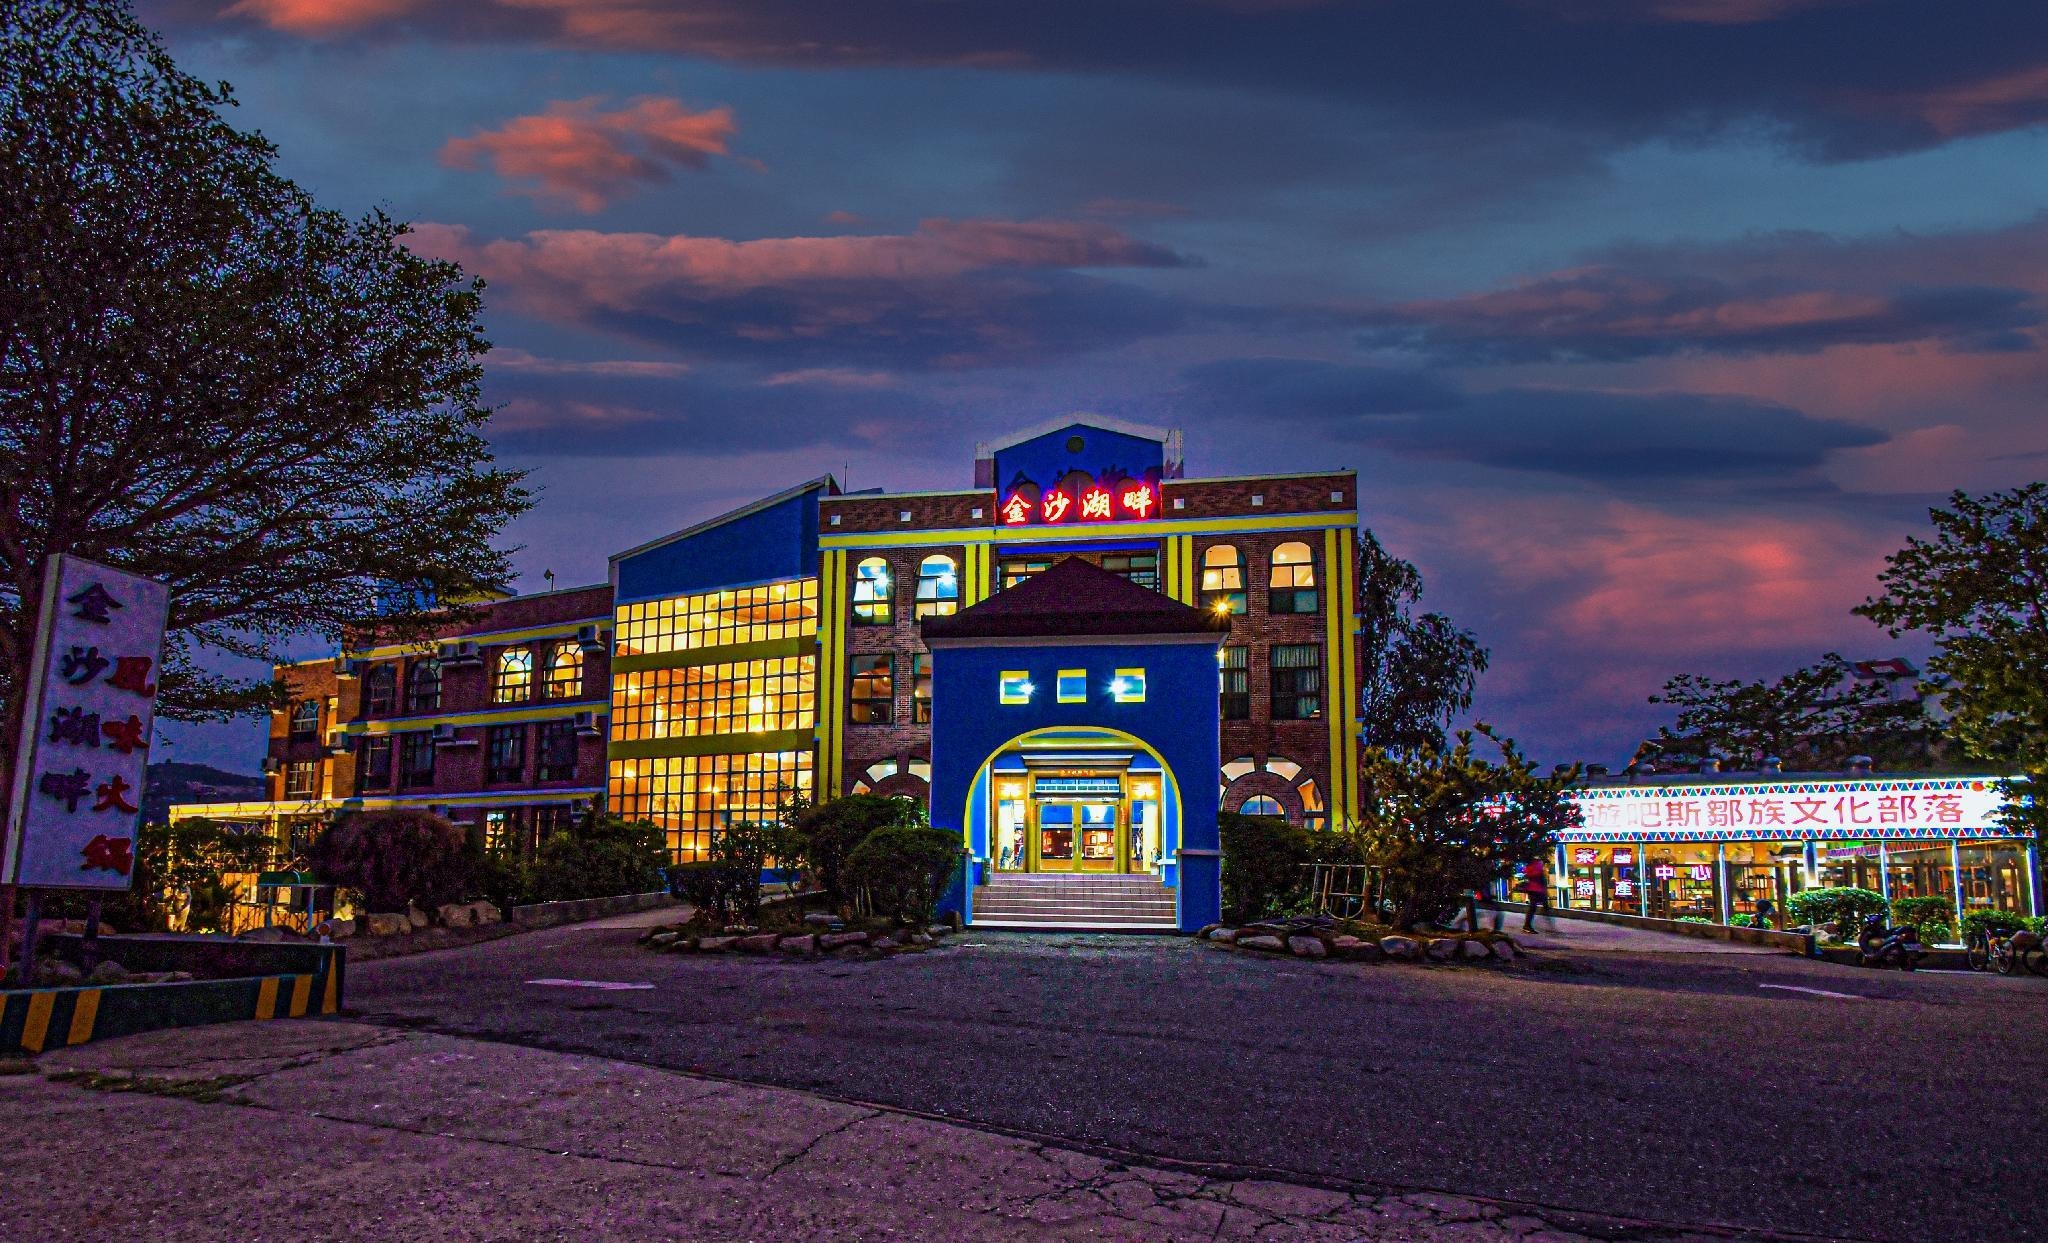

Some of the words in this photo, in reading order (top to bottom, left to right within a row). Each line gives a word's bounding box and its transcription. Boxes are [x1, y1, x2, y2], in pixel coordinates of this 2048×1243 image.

[1003, 485, 1152, 523] 金沙湖畔
[40, 583, 123, 813] 金沙湖畔
